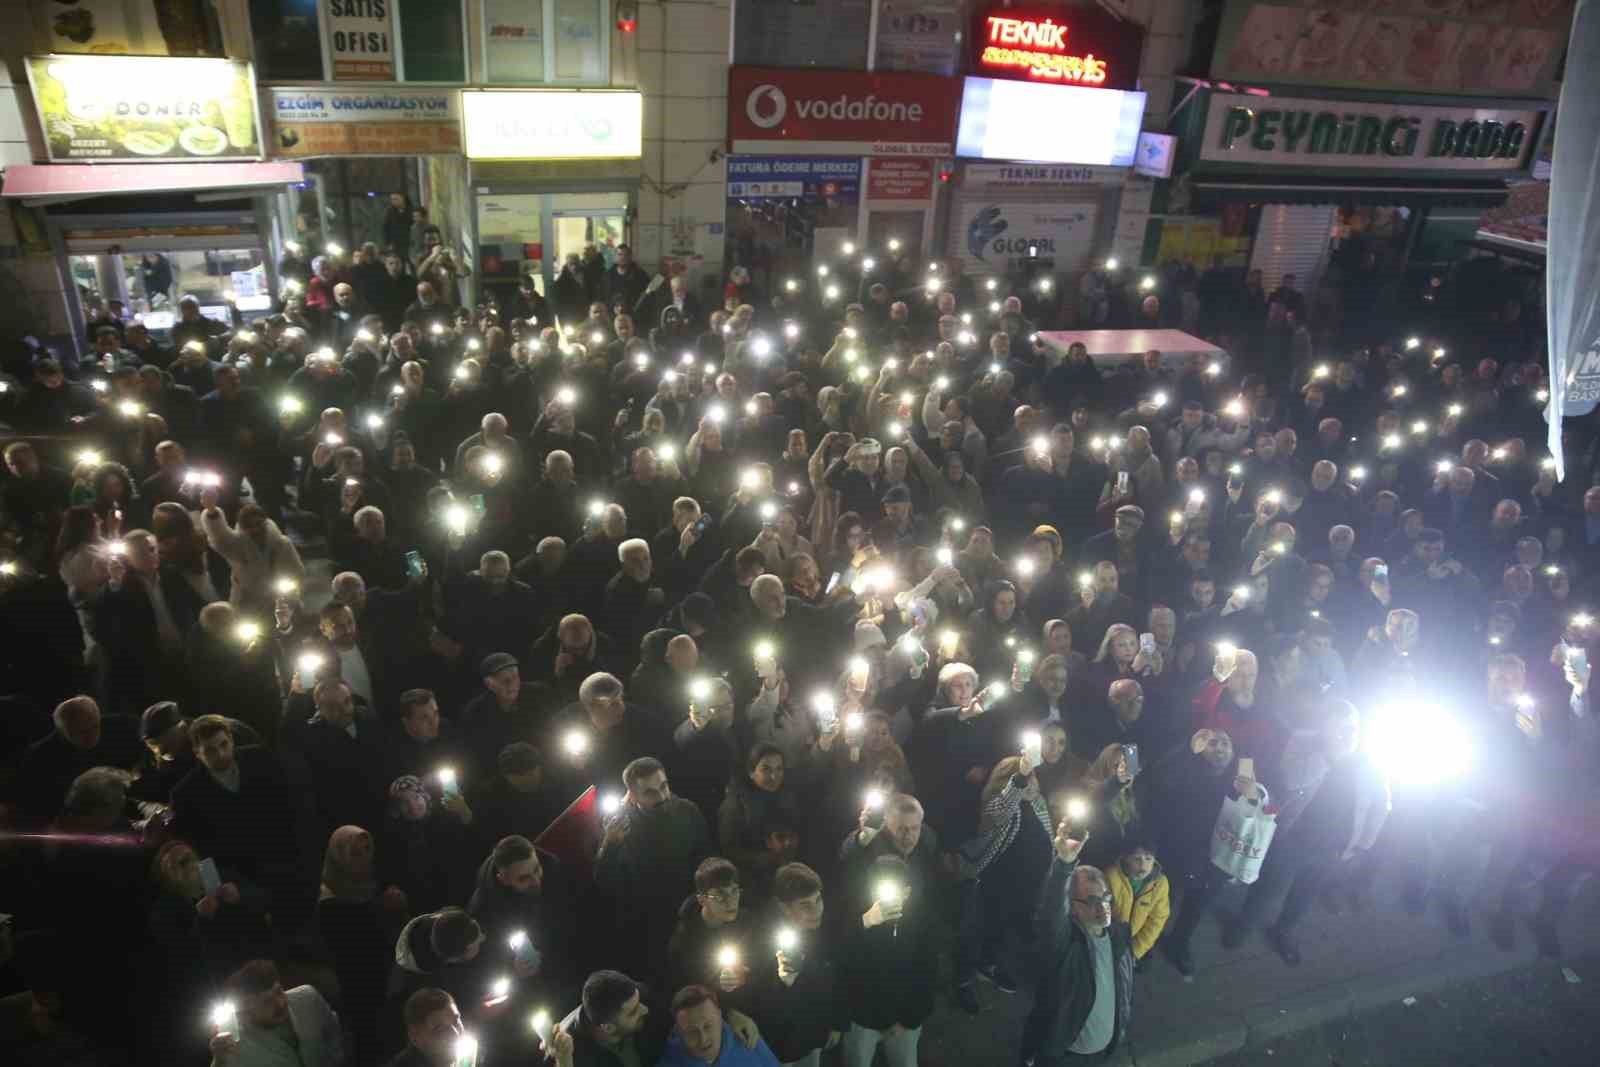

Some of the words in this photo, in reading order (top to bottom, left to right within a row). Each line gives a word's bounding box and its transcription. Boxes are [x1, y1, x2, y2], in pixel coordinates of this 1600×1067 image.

[987, 16, 1068, 50] TEKNİK
[794, 95, 923, 121] vodafone
[728, 162, 770, 174] FATURA
[772, 160, 810, 174] ÖDEME
